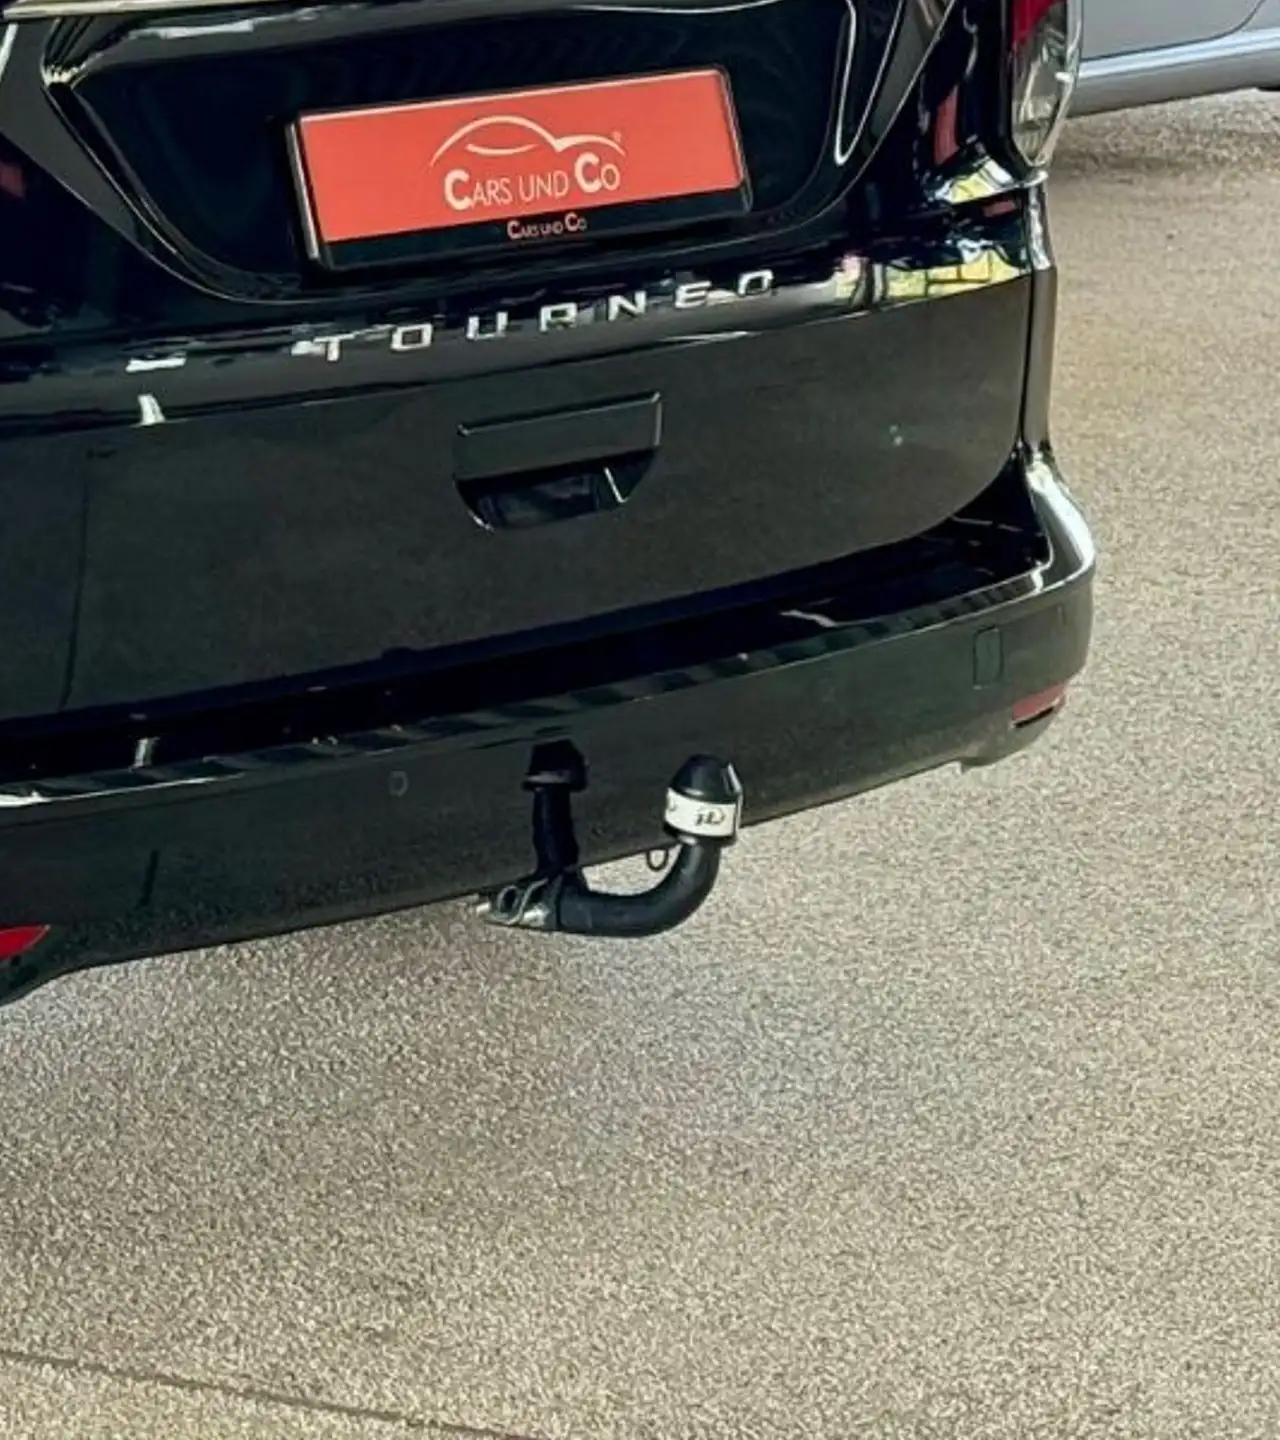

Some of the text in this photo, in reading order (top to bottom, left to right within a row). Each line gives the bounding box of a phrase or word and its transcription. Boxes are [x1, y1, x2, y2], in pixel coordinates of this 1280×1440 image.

[443, 168, 512, 211] CARS
[518, 170, 570, 202] UND
[311, 270, 776, 362] TOURNEO
